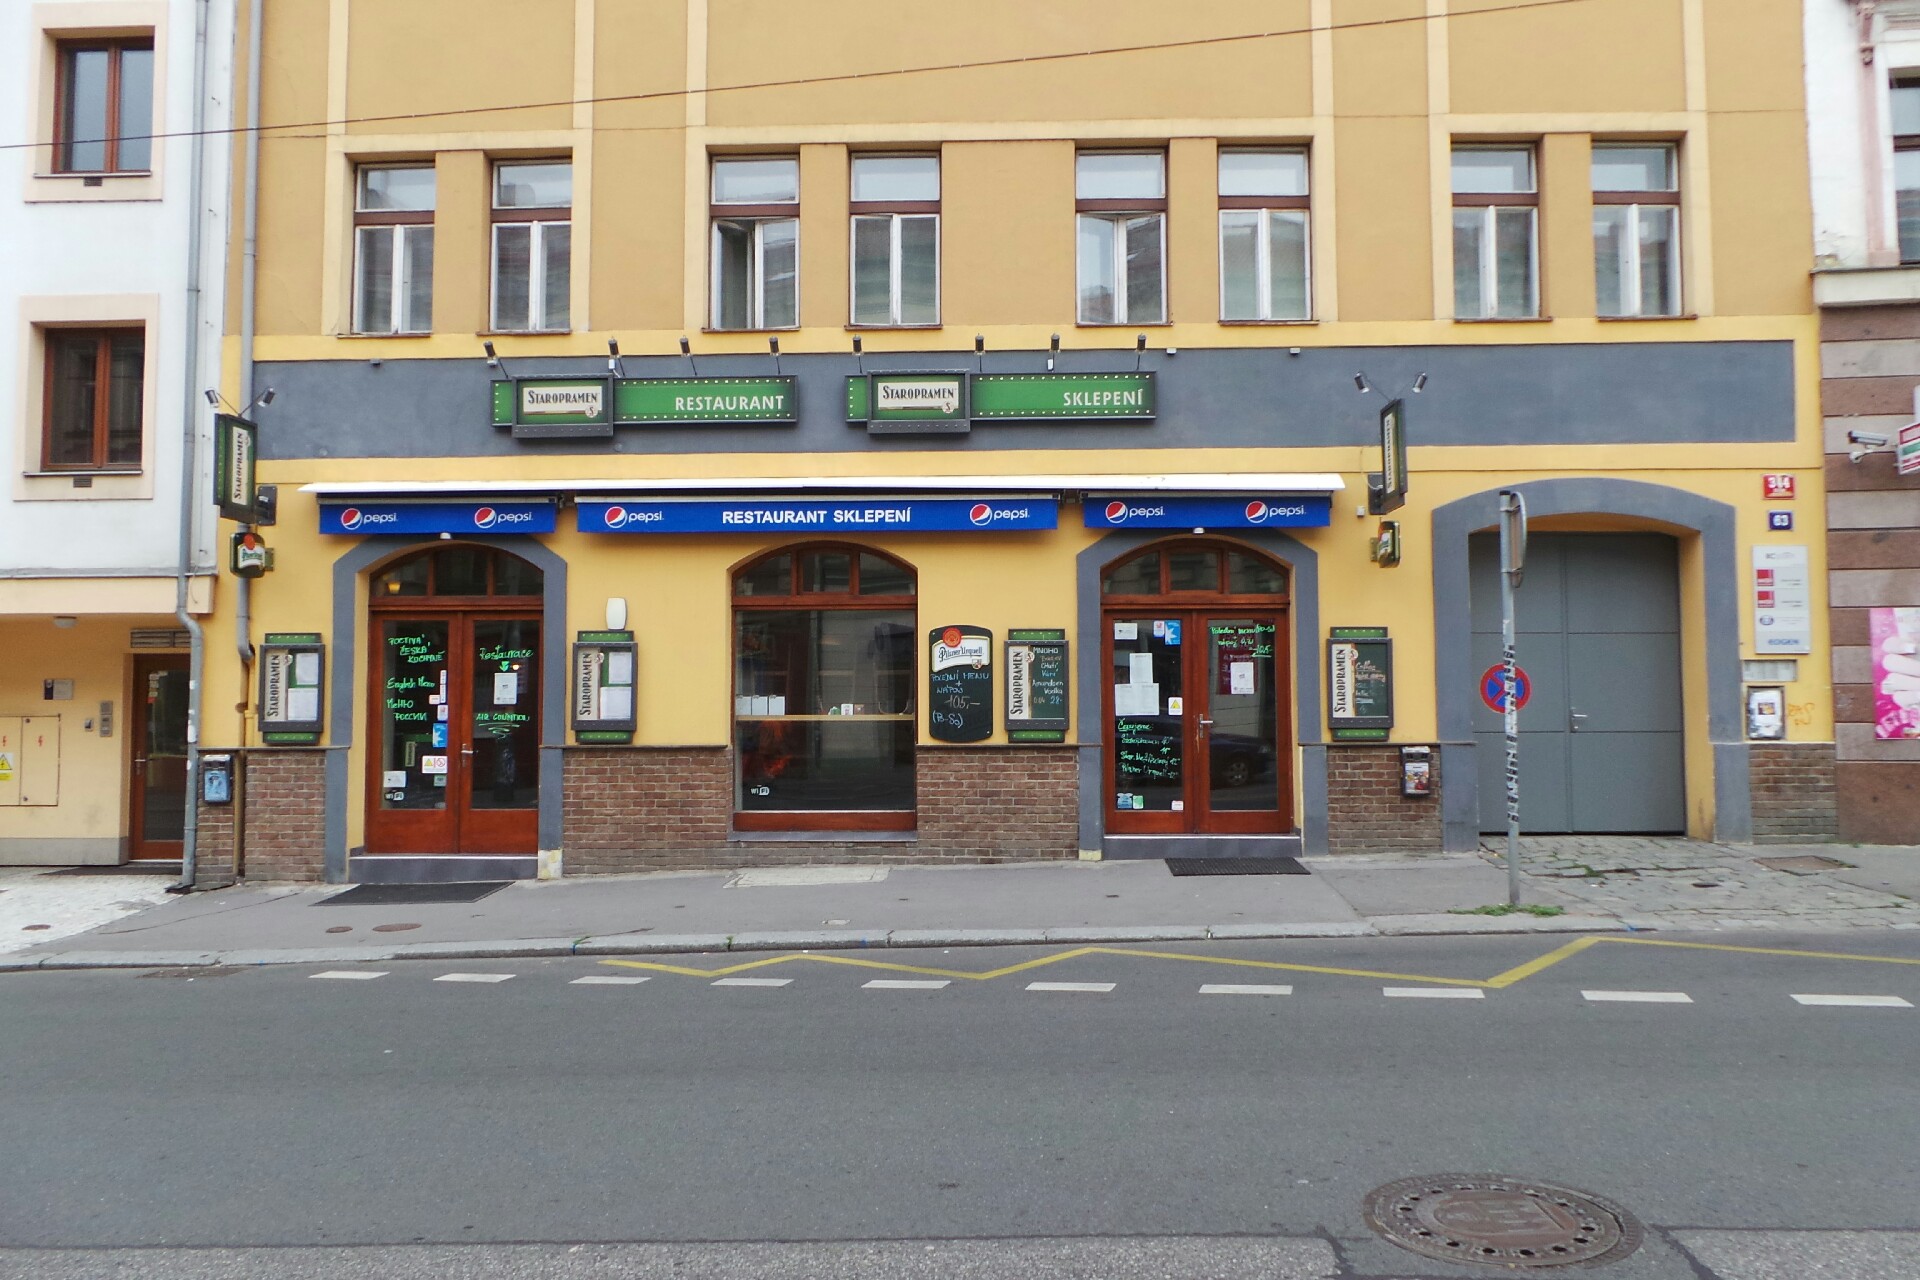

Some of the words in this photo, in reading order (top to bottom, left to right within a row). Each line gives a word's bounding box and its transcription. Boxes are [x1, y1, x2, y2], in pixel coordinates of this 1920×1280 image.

[528, 389, 598, 404] STAROPRAMEN
[883, 385, 954, 399] STAROPRAMEN
[1063, 388, 1143, 406] SKLEPENÍ
[675, 395, 784, 411] RESTAURANT
[233, 432, 244, 499] STAROPRAMEN
[498, 511, 533, 524] pepsi
[629, 510, 664, 523] pepsi
[722, 510, 827, 524] RESTAURANT
[833, 507, 911, 523] SKLEPENÍ
[993, 507, 1030, 521] pepsi
[1129, 505, 1165, 518] pepsi
[1269, 504, 1306, 517] pepsi
[364, 512, 398, 525] pepsi
[1032, 646, 1059, 654] MNOHO
[266, 654, 280, 717] STAROPRAMEN
[579, 652, 592, 716] STAROPRAMEN
[1010, 650, 1024, 715] STAROPRAMEN
[1334, 649, 1346, 713] STAROPRAMEN
